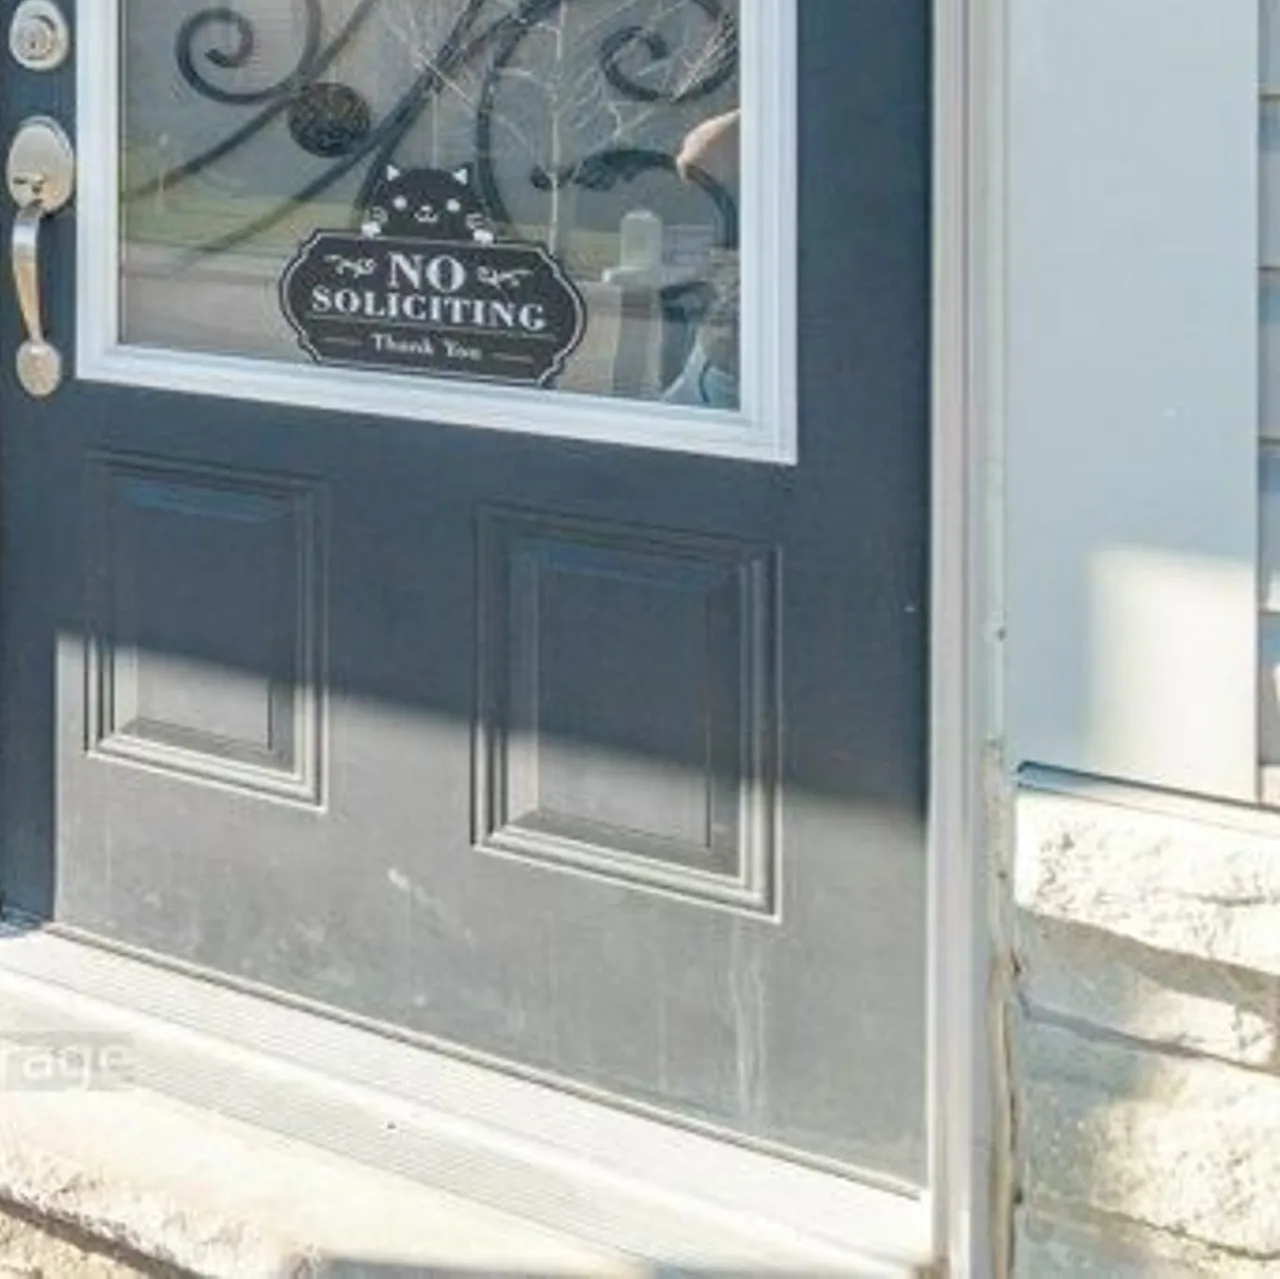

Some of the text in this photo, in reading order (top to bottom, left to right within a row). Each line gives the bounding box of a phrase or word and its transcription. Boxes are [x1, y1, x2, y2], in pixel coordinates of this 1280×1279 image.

[389, 252, 466, 292] NO
[312, 285, 546, 331] SOLICITING
[372, 333, 482, 360] Thank You
